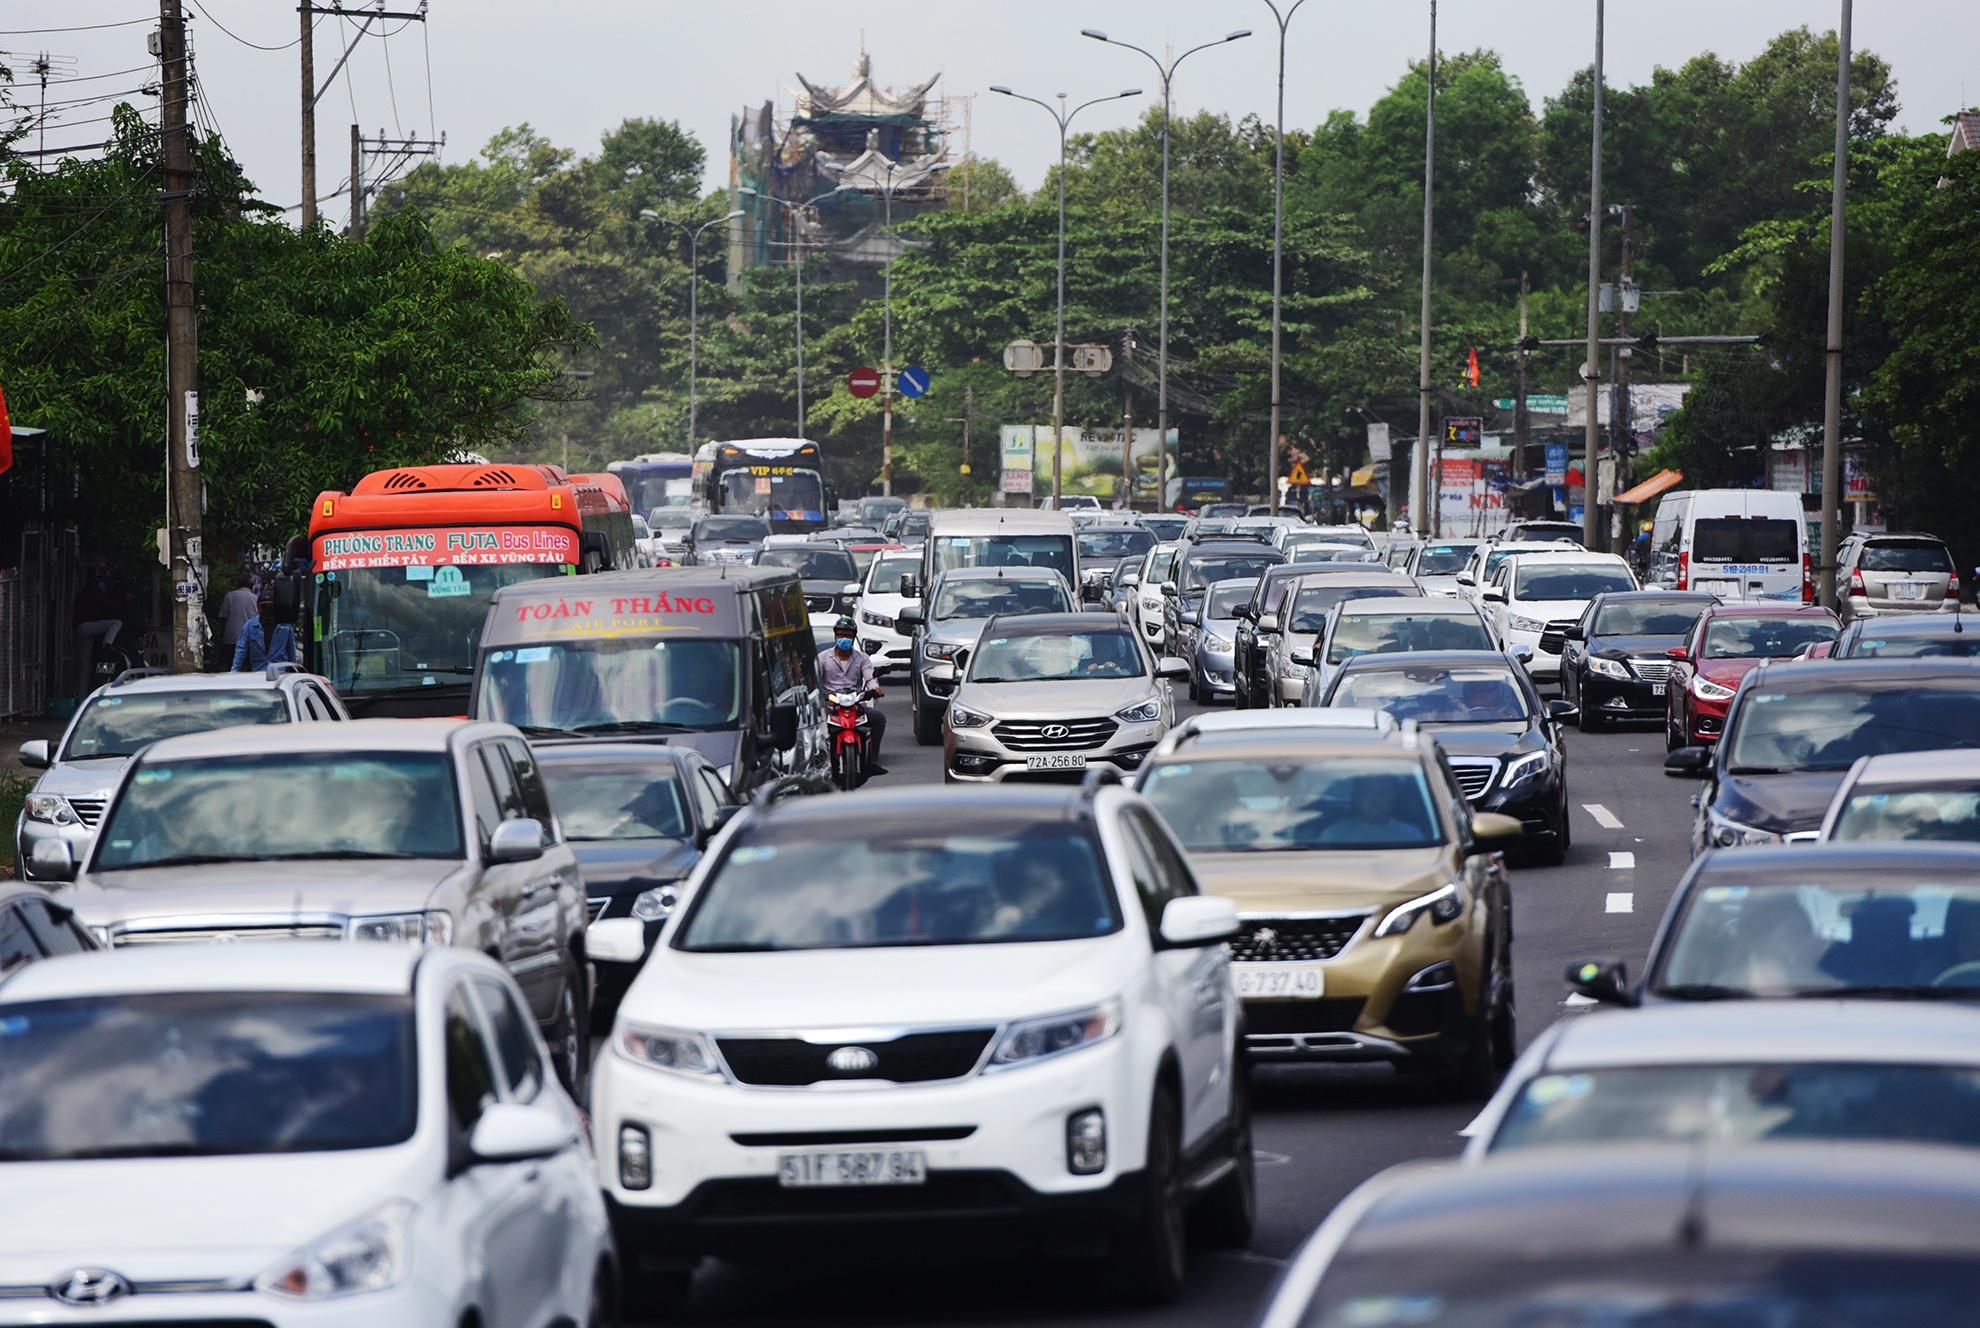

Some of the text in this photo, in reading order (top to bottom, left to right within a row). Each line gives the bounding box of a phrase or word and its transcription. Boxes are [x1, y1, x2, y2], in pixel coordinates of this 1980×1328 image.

[750, 466, 770, 476] VIP
[324, 531, 569, 556] PHƯƠNG TRANG FUTA Bus Lines
[322, 551, 565, 570] BẾN XE MIỀN TÂY BẾN XE VŨNG TÀU
[441, 570, 455, 583] 11
[515, 590, 715, 622] TOÀN THẮNG
[572, 618, 662, 629] AIR PORT
